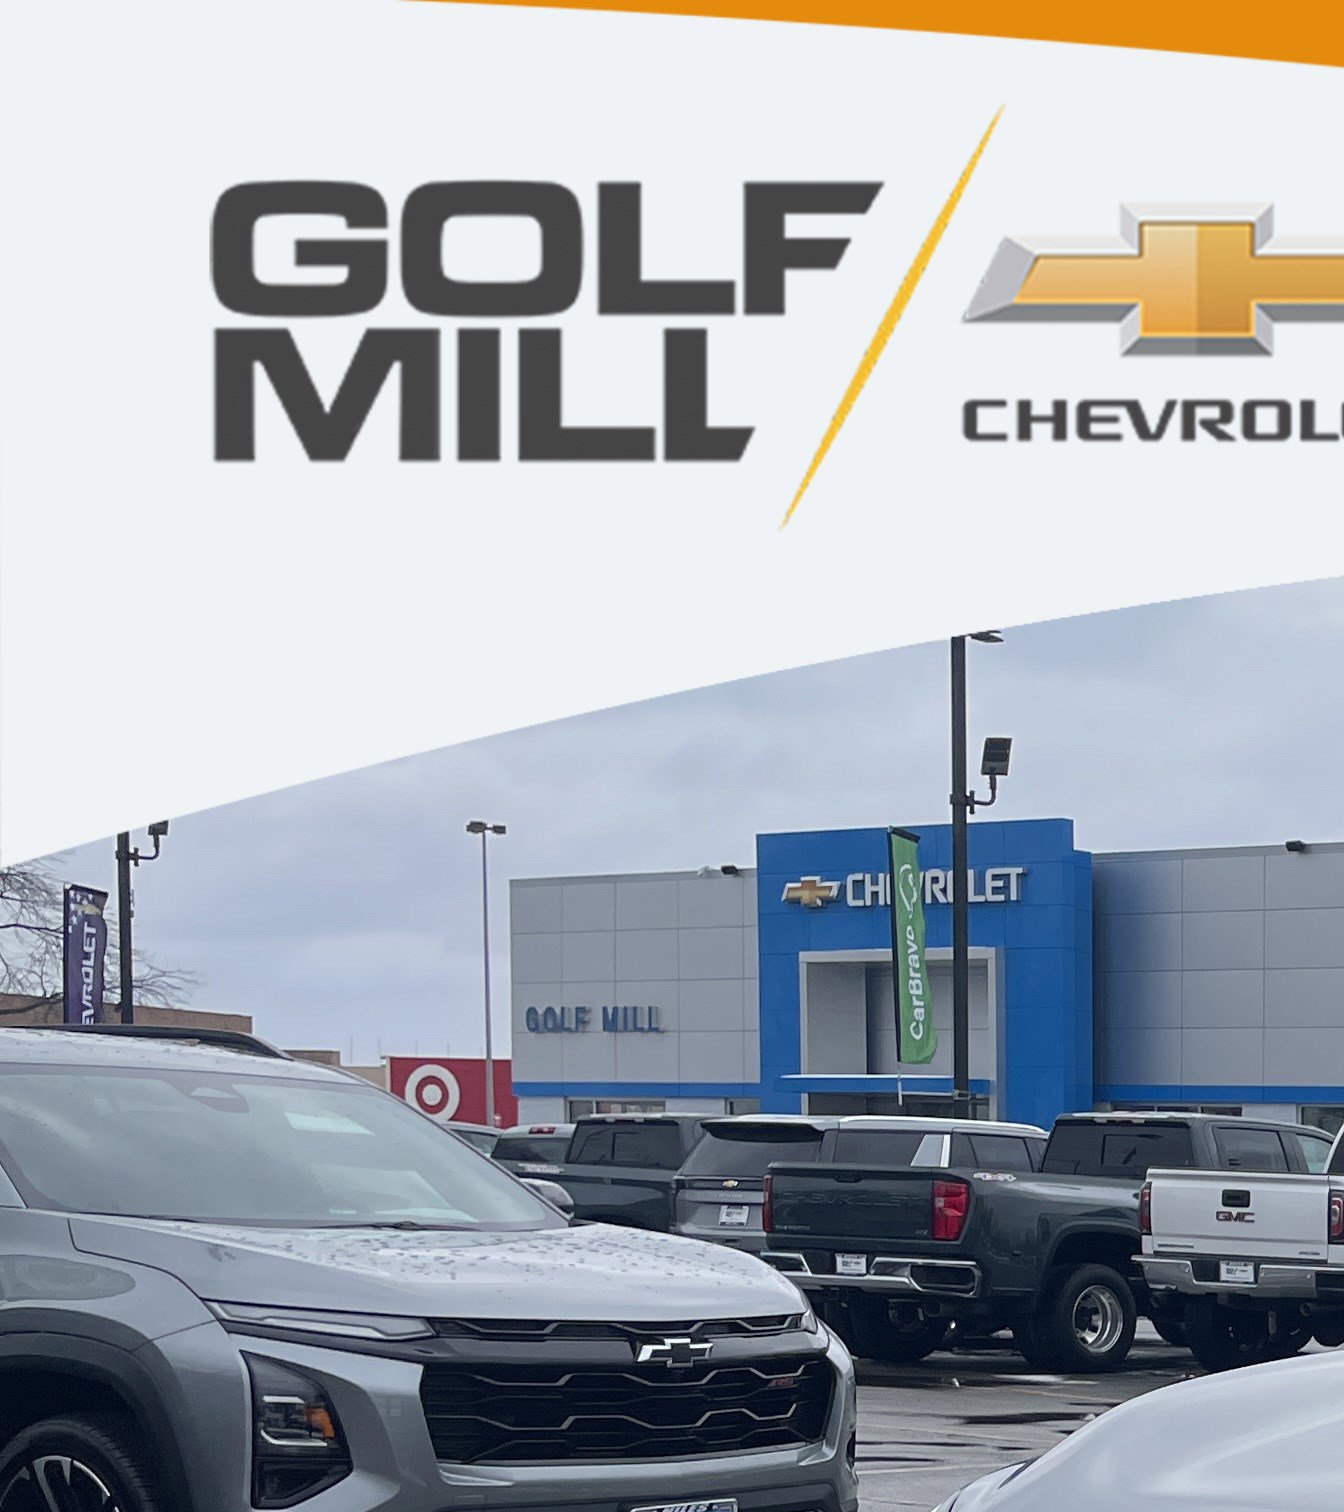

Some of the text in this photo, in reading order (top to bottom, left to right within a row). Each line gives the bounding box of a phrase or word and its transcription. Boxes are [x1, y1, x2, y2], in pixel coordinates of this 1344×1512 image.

[846, 867, 1023, 907] CHRLET
[906, 925, 925, 1040] CarBravo
[525, 1006, 663, 1033] GOLF MILL
[1215, 1210, 1256, 1224] GMC
